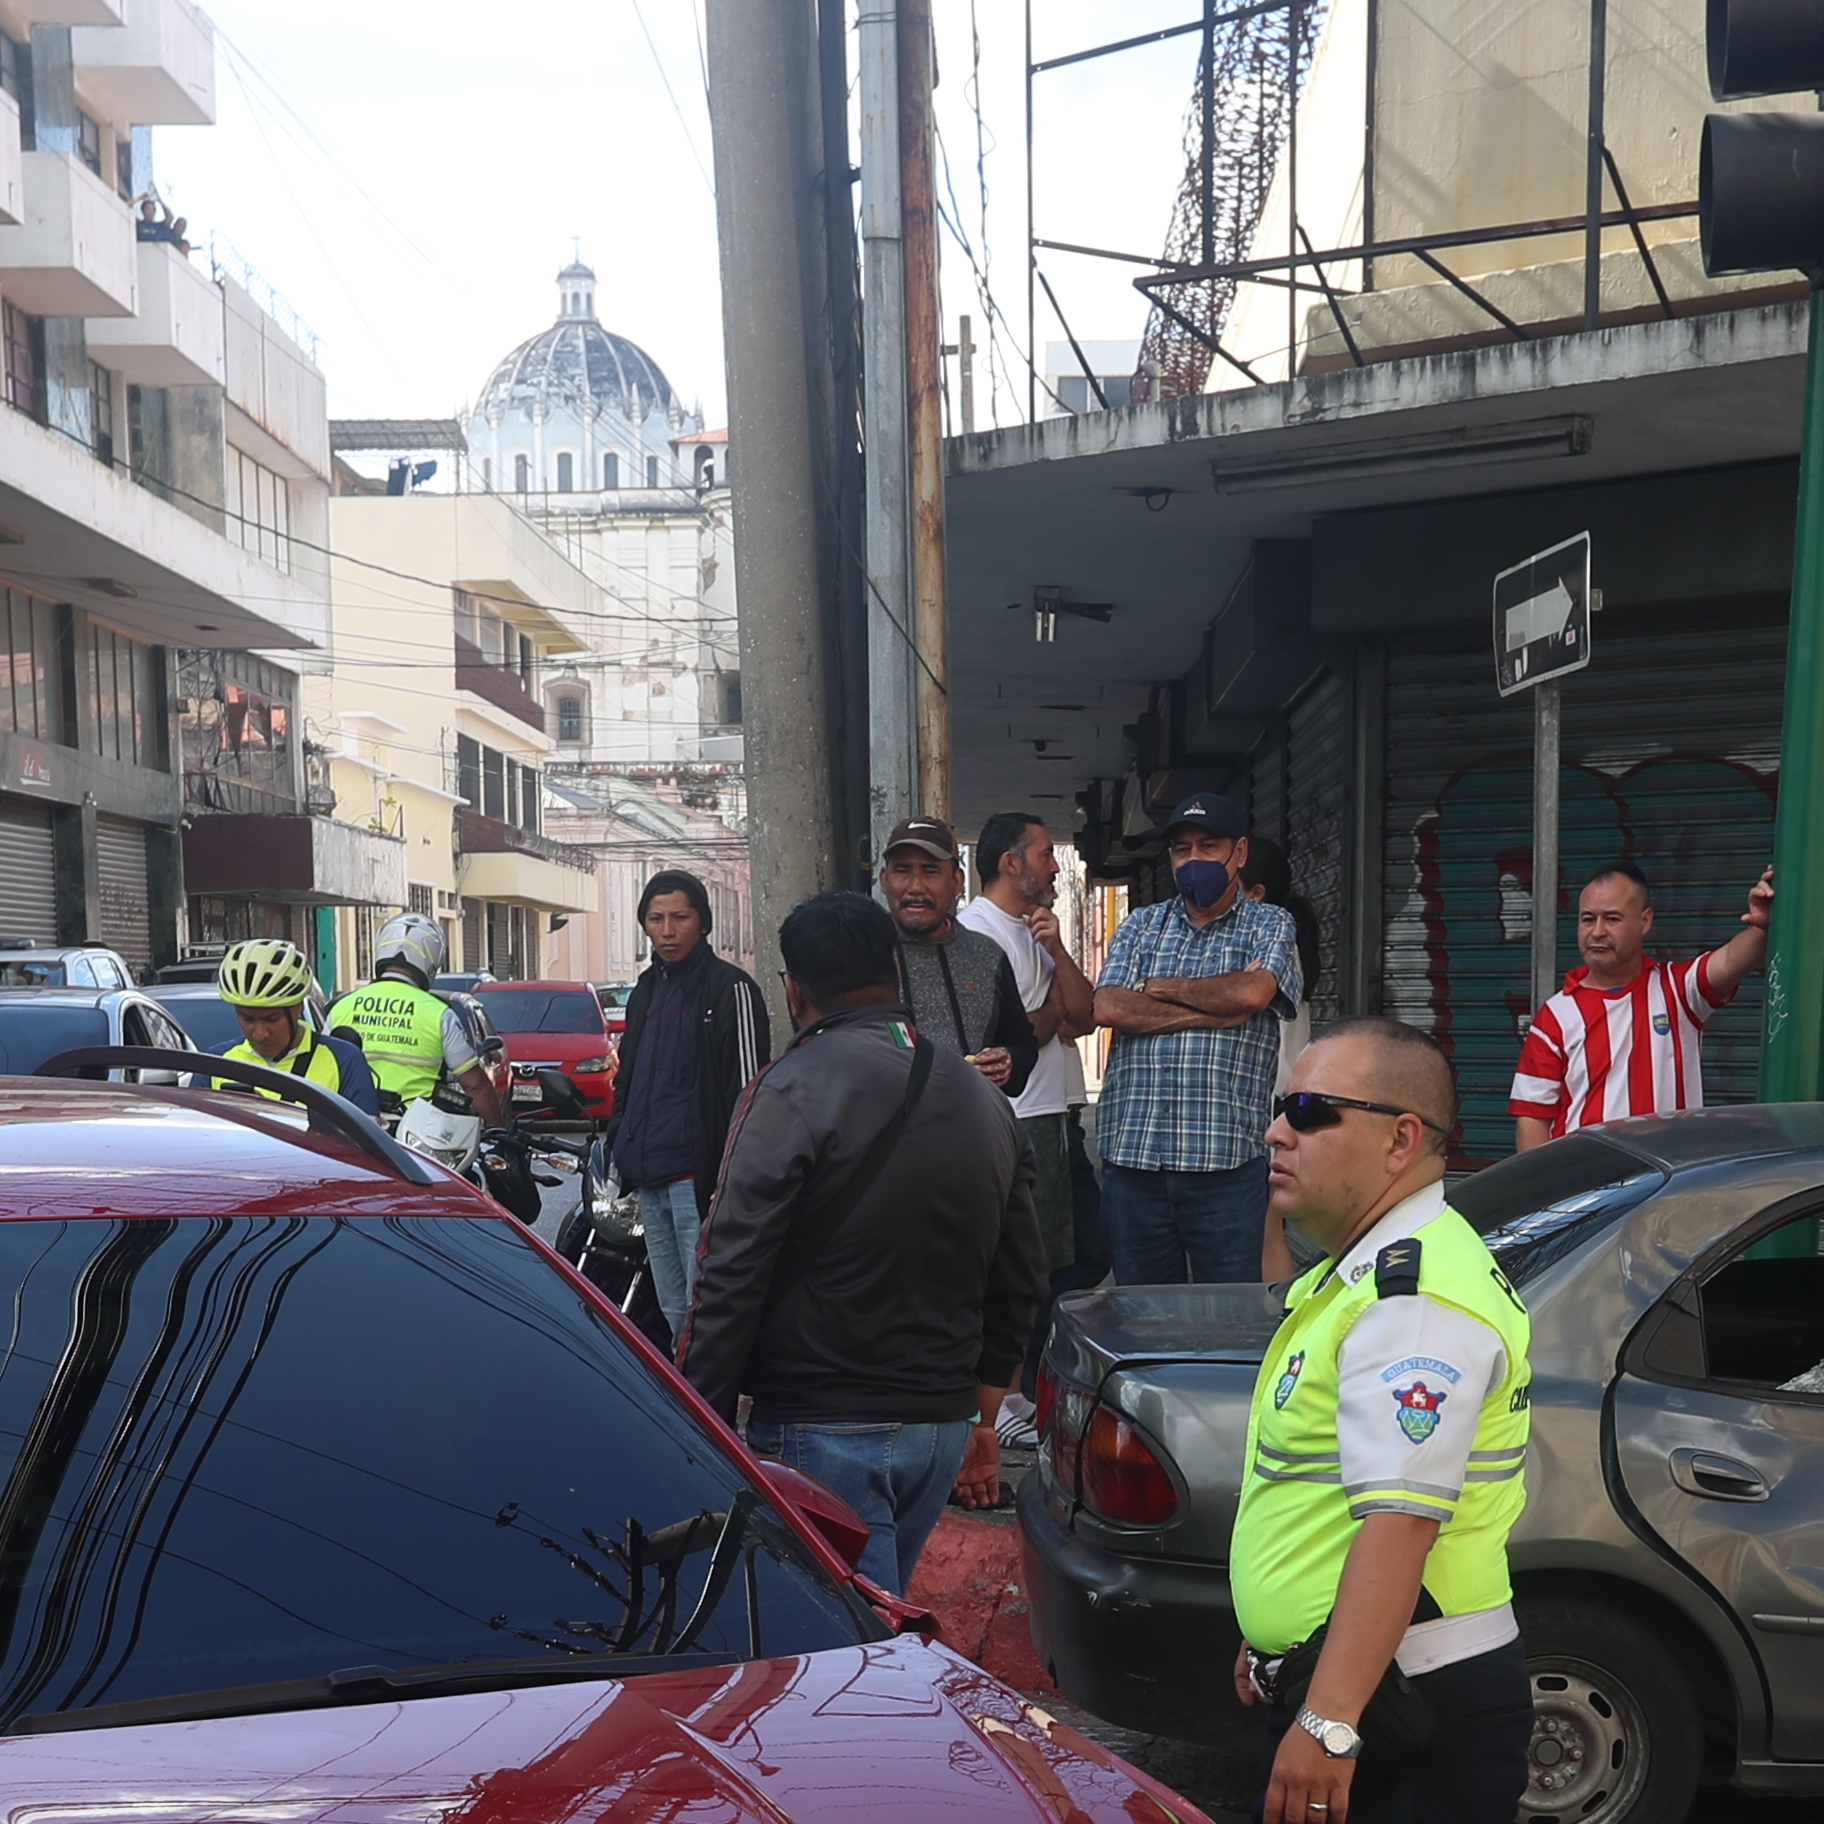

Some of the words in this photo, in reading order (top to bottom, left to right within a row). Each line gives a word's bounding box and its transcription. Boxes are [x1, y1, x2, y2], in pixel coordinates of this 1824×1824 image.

[352, 996, 415, 1016] POLICIA
[350, 1014, 413, 1030] MUNICIPAL
[377, 1033, 419, 1047] GUATEMALA
[1386, 1358, 1456, 1381] GUATEMALA
